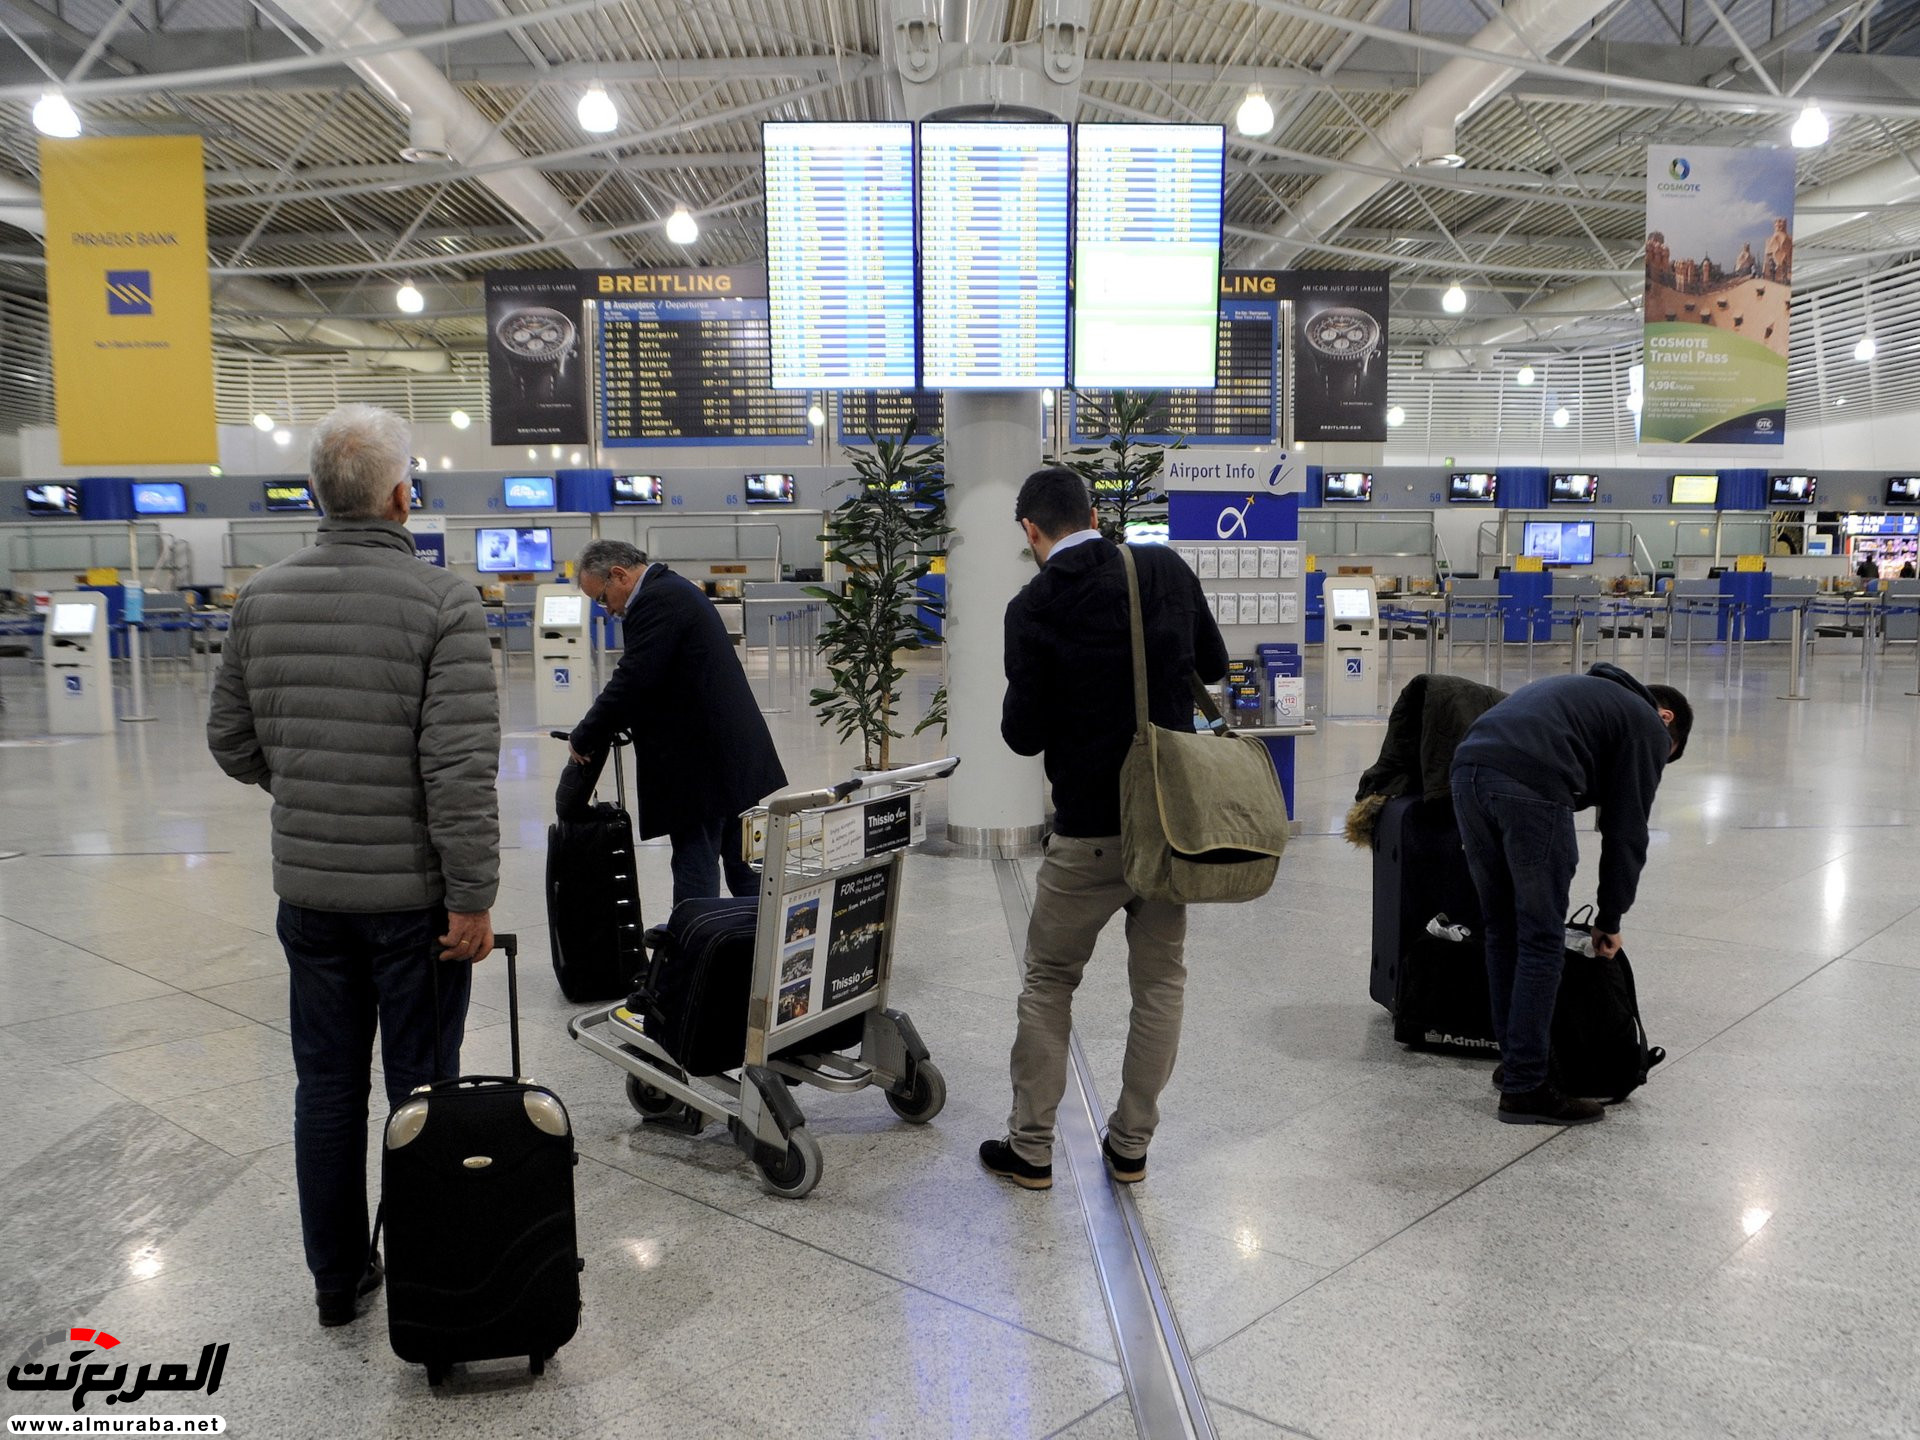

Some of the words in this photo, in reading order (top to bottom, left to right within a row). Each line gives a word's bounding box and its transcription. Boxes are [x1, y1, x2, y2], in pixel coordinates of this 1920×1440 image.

[1657, 183, 1701, 192] COSMOTE
[72, 232, 134, 247] PIRAEUS
[137, 232, 179, 247] BANK
[598, 275, 731, 293] BREITLING
[1650, 337, 1708, 348] COSMOTE
[1650, 350, 1693, 363] Travel
[1697, 351, 1728, 363] Pass
[1170, 462, 1219, 482] Airport
[1226, 463, 1255, 479] Info
[868, 811, 894, 828] Thissio
[840, 881, 855, 896] FOR
[832, 972, 860, 992] Thissio
[1443, 1033, 1500, 1049] Admira
